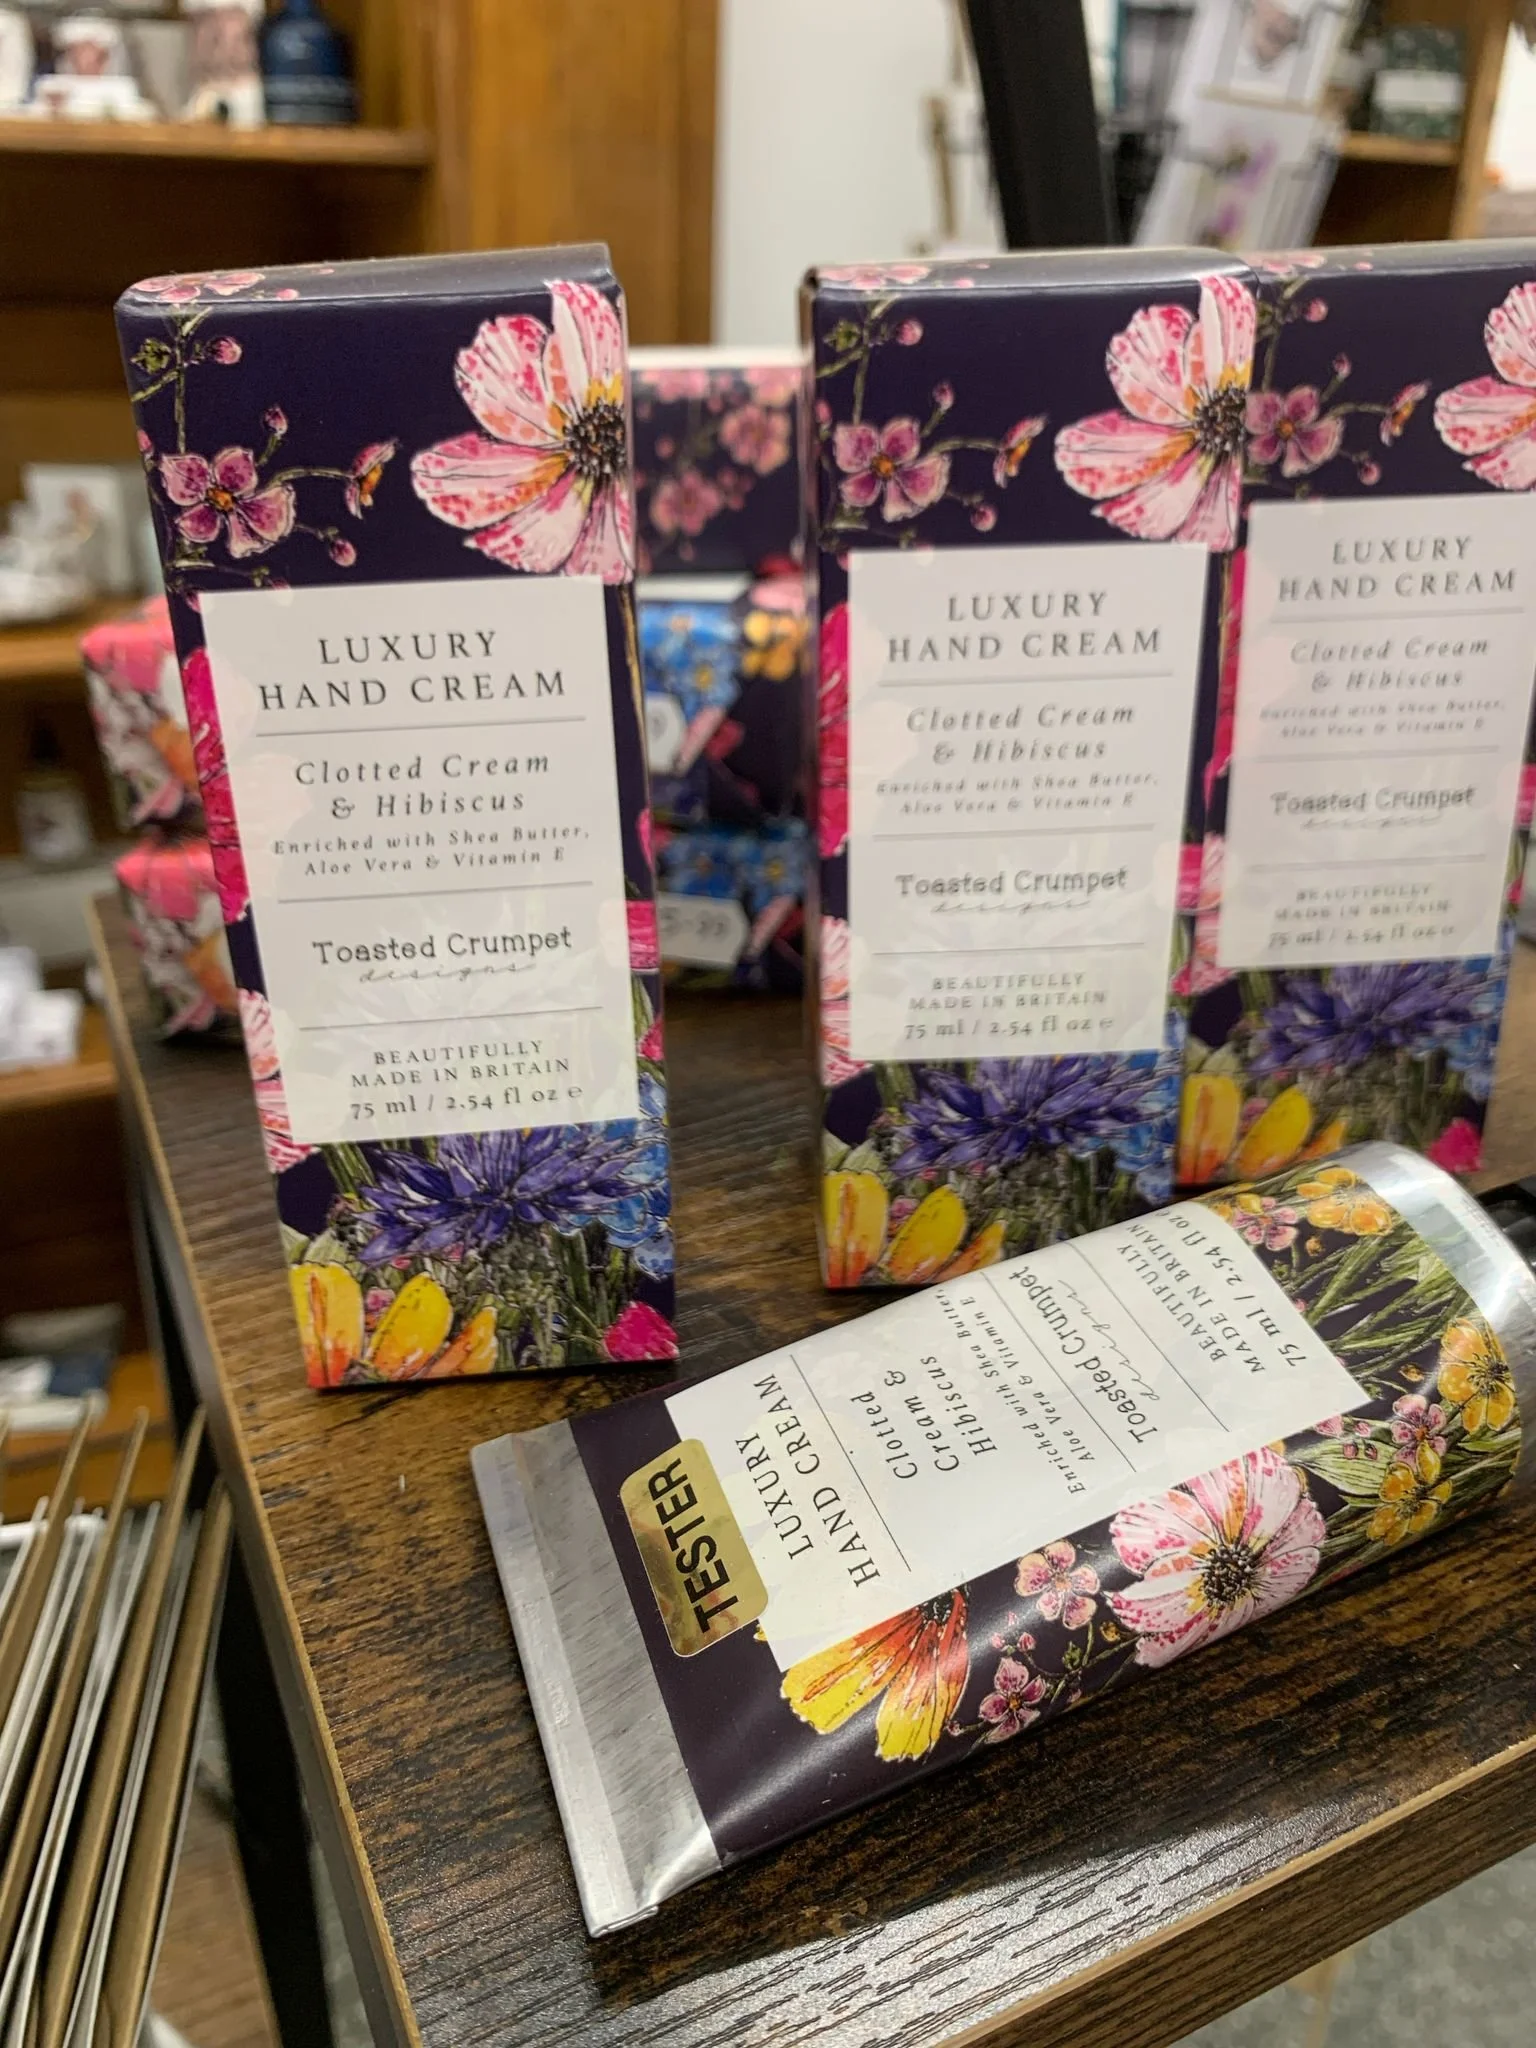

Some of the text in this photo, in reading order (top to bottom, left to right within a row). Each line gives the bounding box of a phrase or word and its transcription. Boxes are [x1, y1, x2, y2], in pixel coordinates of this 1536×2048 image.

[1333, 535, 1472, 565] LUXURY
[1278, 568, 1516, 602] HAND CREAM
[947, 591, 1108, 622] LUXURY
[319, 630, 498, 665] LUXURY
[887, 628, 1162, 663] HAND CREAM
[1289, 635, 1489, 664] Clotted Cream
[258, 670, 566, 711] HAND CREAM
[1346, 669, 1464, 692] Hibiscus
[906, 704, 1135, 733] Clotted Cream
[933, 739, 1107, 764] & Hibiscus
[295, 752, 551, 786] Clotted Cream
[331, 791, 525, 819] & Hibiscus
[1269, 785, 1478, 816] Toasted Crumpet
[272, 823, 591, 856] Enriched with Shea Butter,
[304, 846, 565, 876] Aloe Vera & Vitamin E
[894, 865, 1129, 898] Toasted Crumpet
[312, 926, 574, 965] Toasted Crumpet
[932, 971, 1087, 991] BEAUTIFULLY
[909, 990, 1107, 1011] MADE IN BRITAIN
[904, 1022, 927, 1041] 75
[935, 1018, 964, 1037] ml
[971, 1019, 979, 1035] /
[989, 1018, 1034, 1035] 2.54
[1041, 1014, 1059, 1033] fl
[1066, 1016, 1092, 1031] oz
[374, 1039, 544, 1066] BEAUTIFULLY
[351, 1057, 570, 1088] MADE IN BRITAIN
[350, 1101, 376, 1120] 75
[385, 1093, 417, 1115] ml
[426, 1094, 436, 1112] /
[446, 1092, 494, 1111] 2.54
[504, 1085, 522, 1105] fl
[531, 1086, 559, 1102] oz
[1168, 1215, 1190, 1229] oz
[1181, 1230, 1207, 1248] fl
[1204, 1245, 1244, 1287] 2.54
[1117, 1243, 1228, 1362] BEAUTIFULLY
[1127, 1223, 1266, 1374] MADE IN BRITAIN
[1233, 1294, 1256, 1302] /
[1245, 1306, 1281, 1338] ml
[1008, 1266, 1161, 1446] Toasted Crumpet
[1057, 1278, 1161, 1401] designs
[1277, 1343, 1307, 1367] 75
[935, 1288, 1087, 1494] Enriched with Shea Butter,
[959, 1296, 1095, 1461] Aloe Vera & Vitamin E
[884, 1369, 960, 1472] Cream &
[920, 1355, 998, 1457] Hibiscus
[850, 1391, 919, 1480] Clotted
[735, 1432, 814, 1560] LUXURY
[753, 1372, 881, 1588] HAND CREAM
[647, 1456, 740, 1634] TESTER
